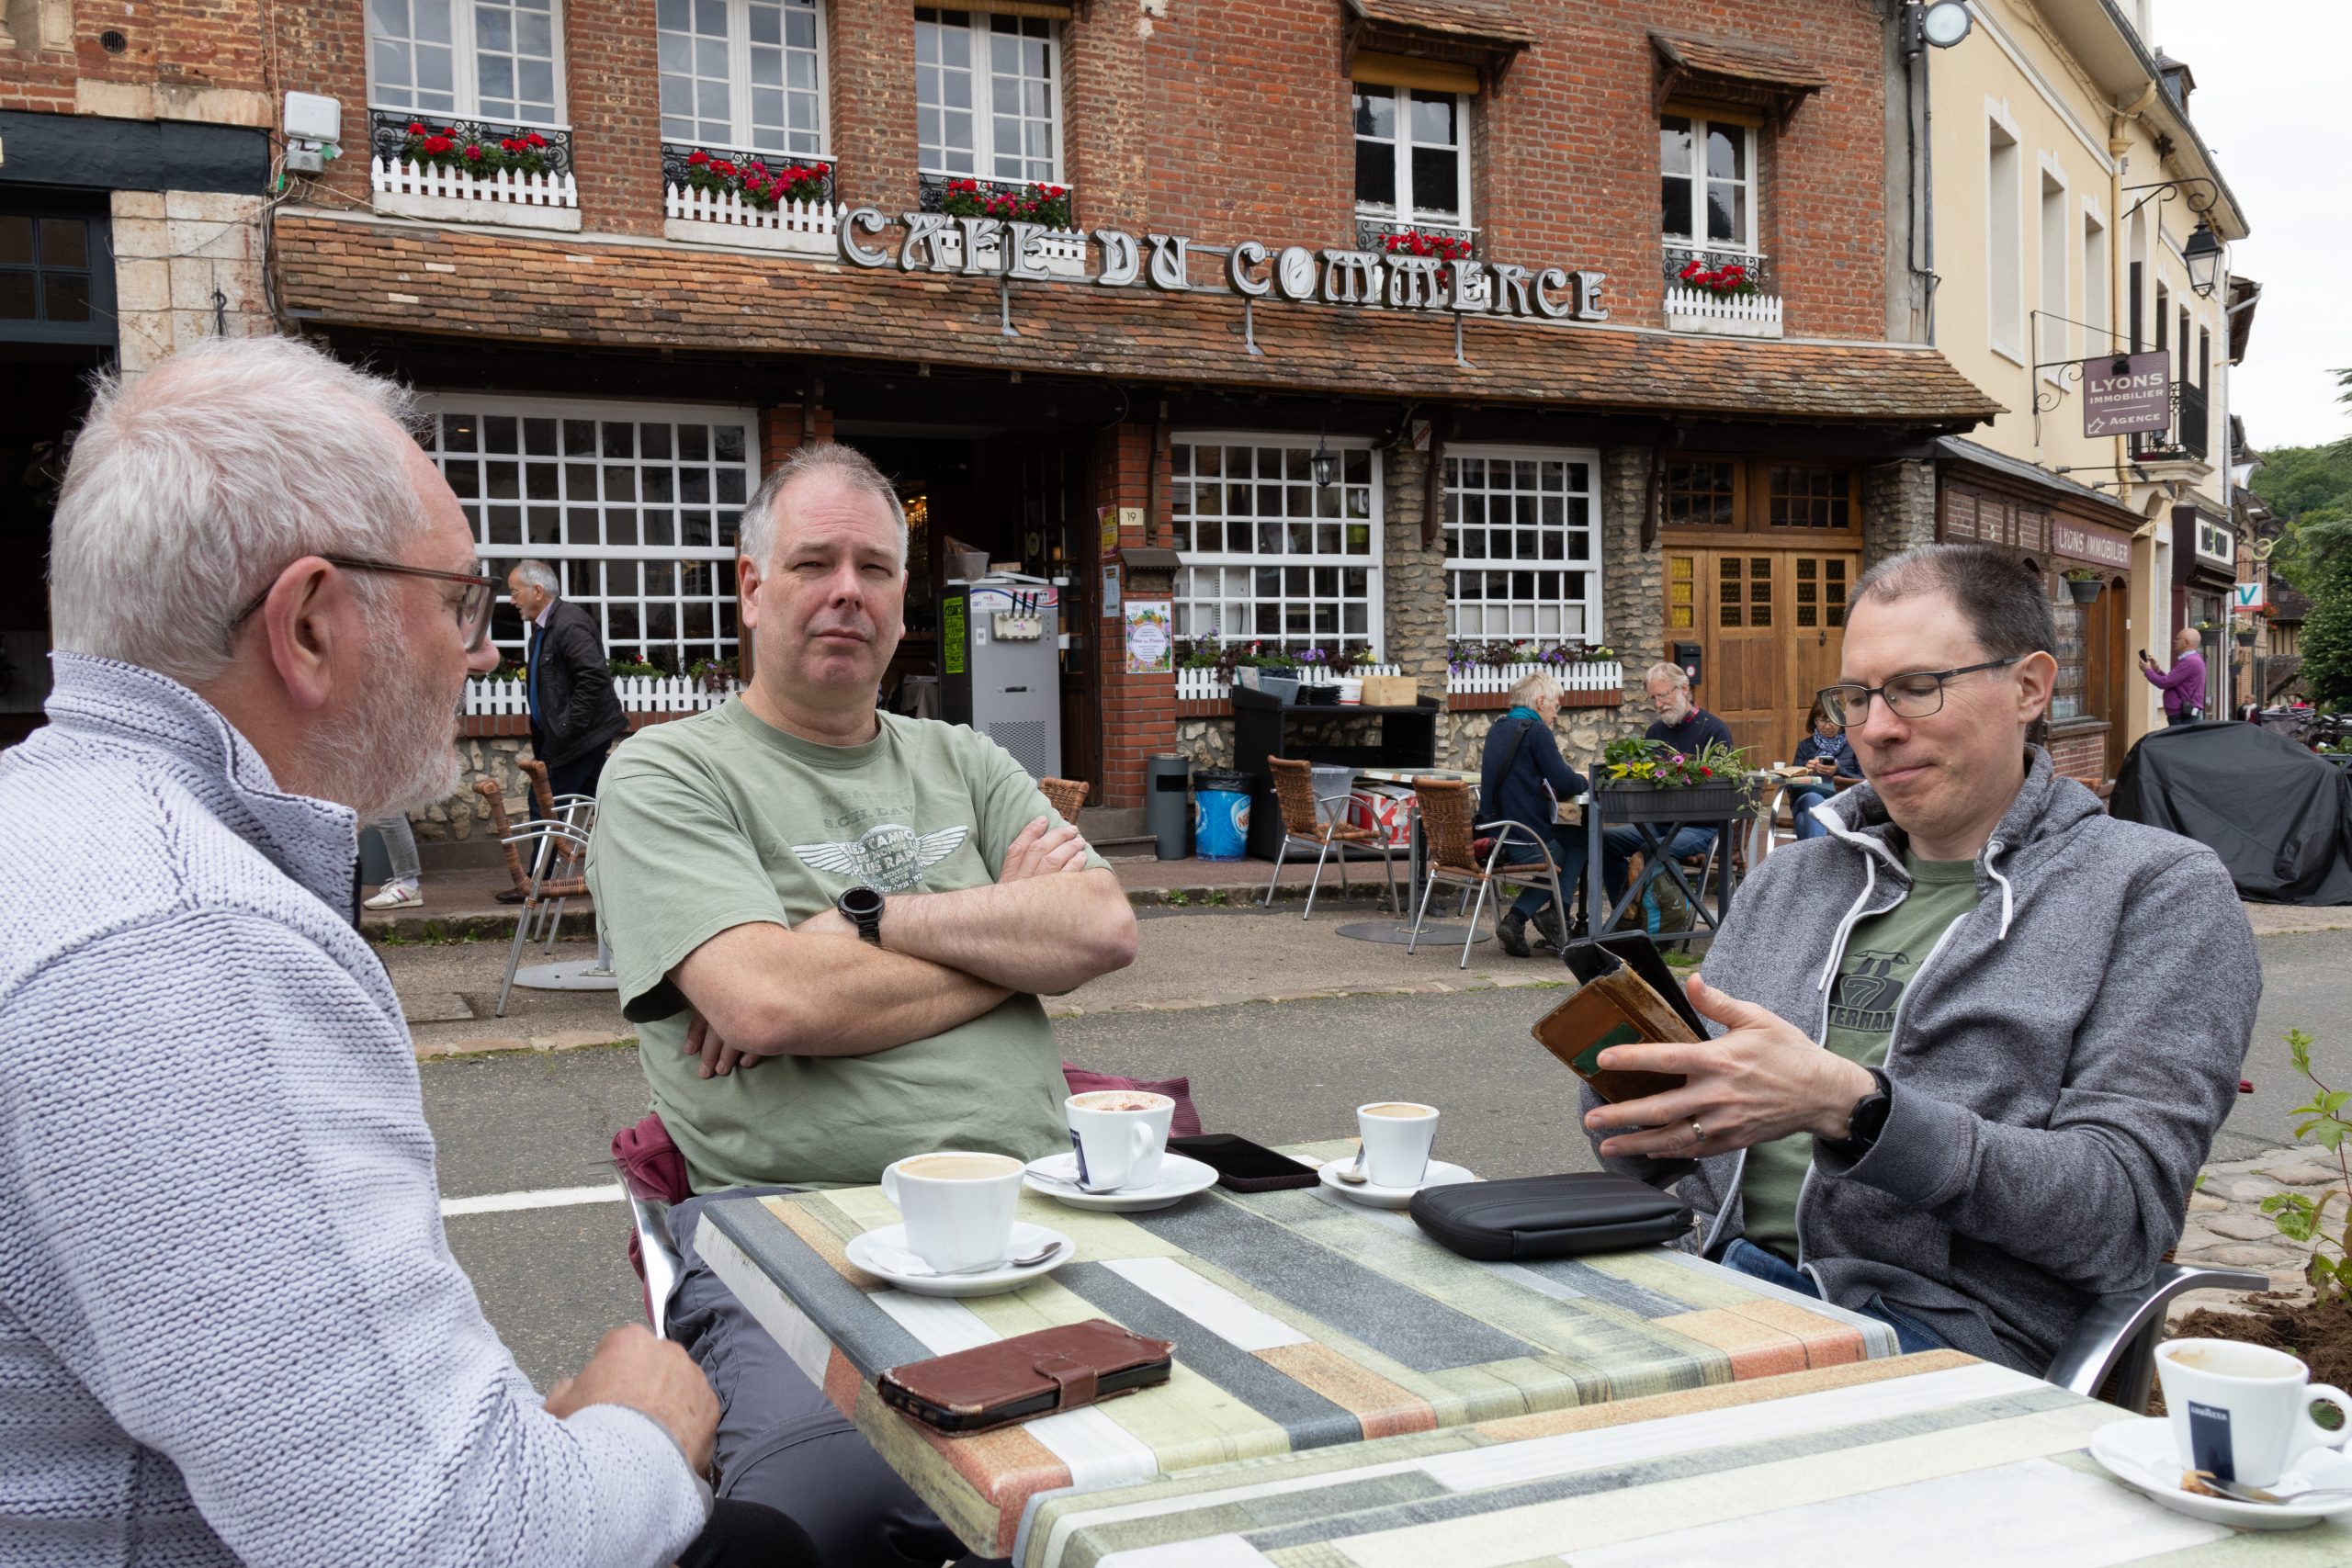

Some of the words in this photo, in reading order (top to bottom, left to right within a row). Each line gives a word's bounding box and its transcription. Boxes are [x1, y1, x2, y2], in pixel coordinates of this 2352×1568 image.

[838, 206, 1050, 281] CAFE
[1088, 229, 1193, 291] DU
[1225, 240, 1610, 322] COMMERCE
[2090, 373, 2164, 393] LYONS
[2089, 389, 2164, 404] IMMOBILIER
[2109, 413, 2161, 425] AGENCE
[1126, 512, 1136, 522] 19
[2059, 526, 2085, 553] LYONS
[2086, 535, 2129, 563] IMMOBILIER
[2238, 585, 2258, 605] V
